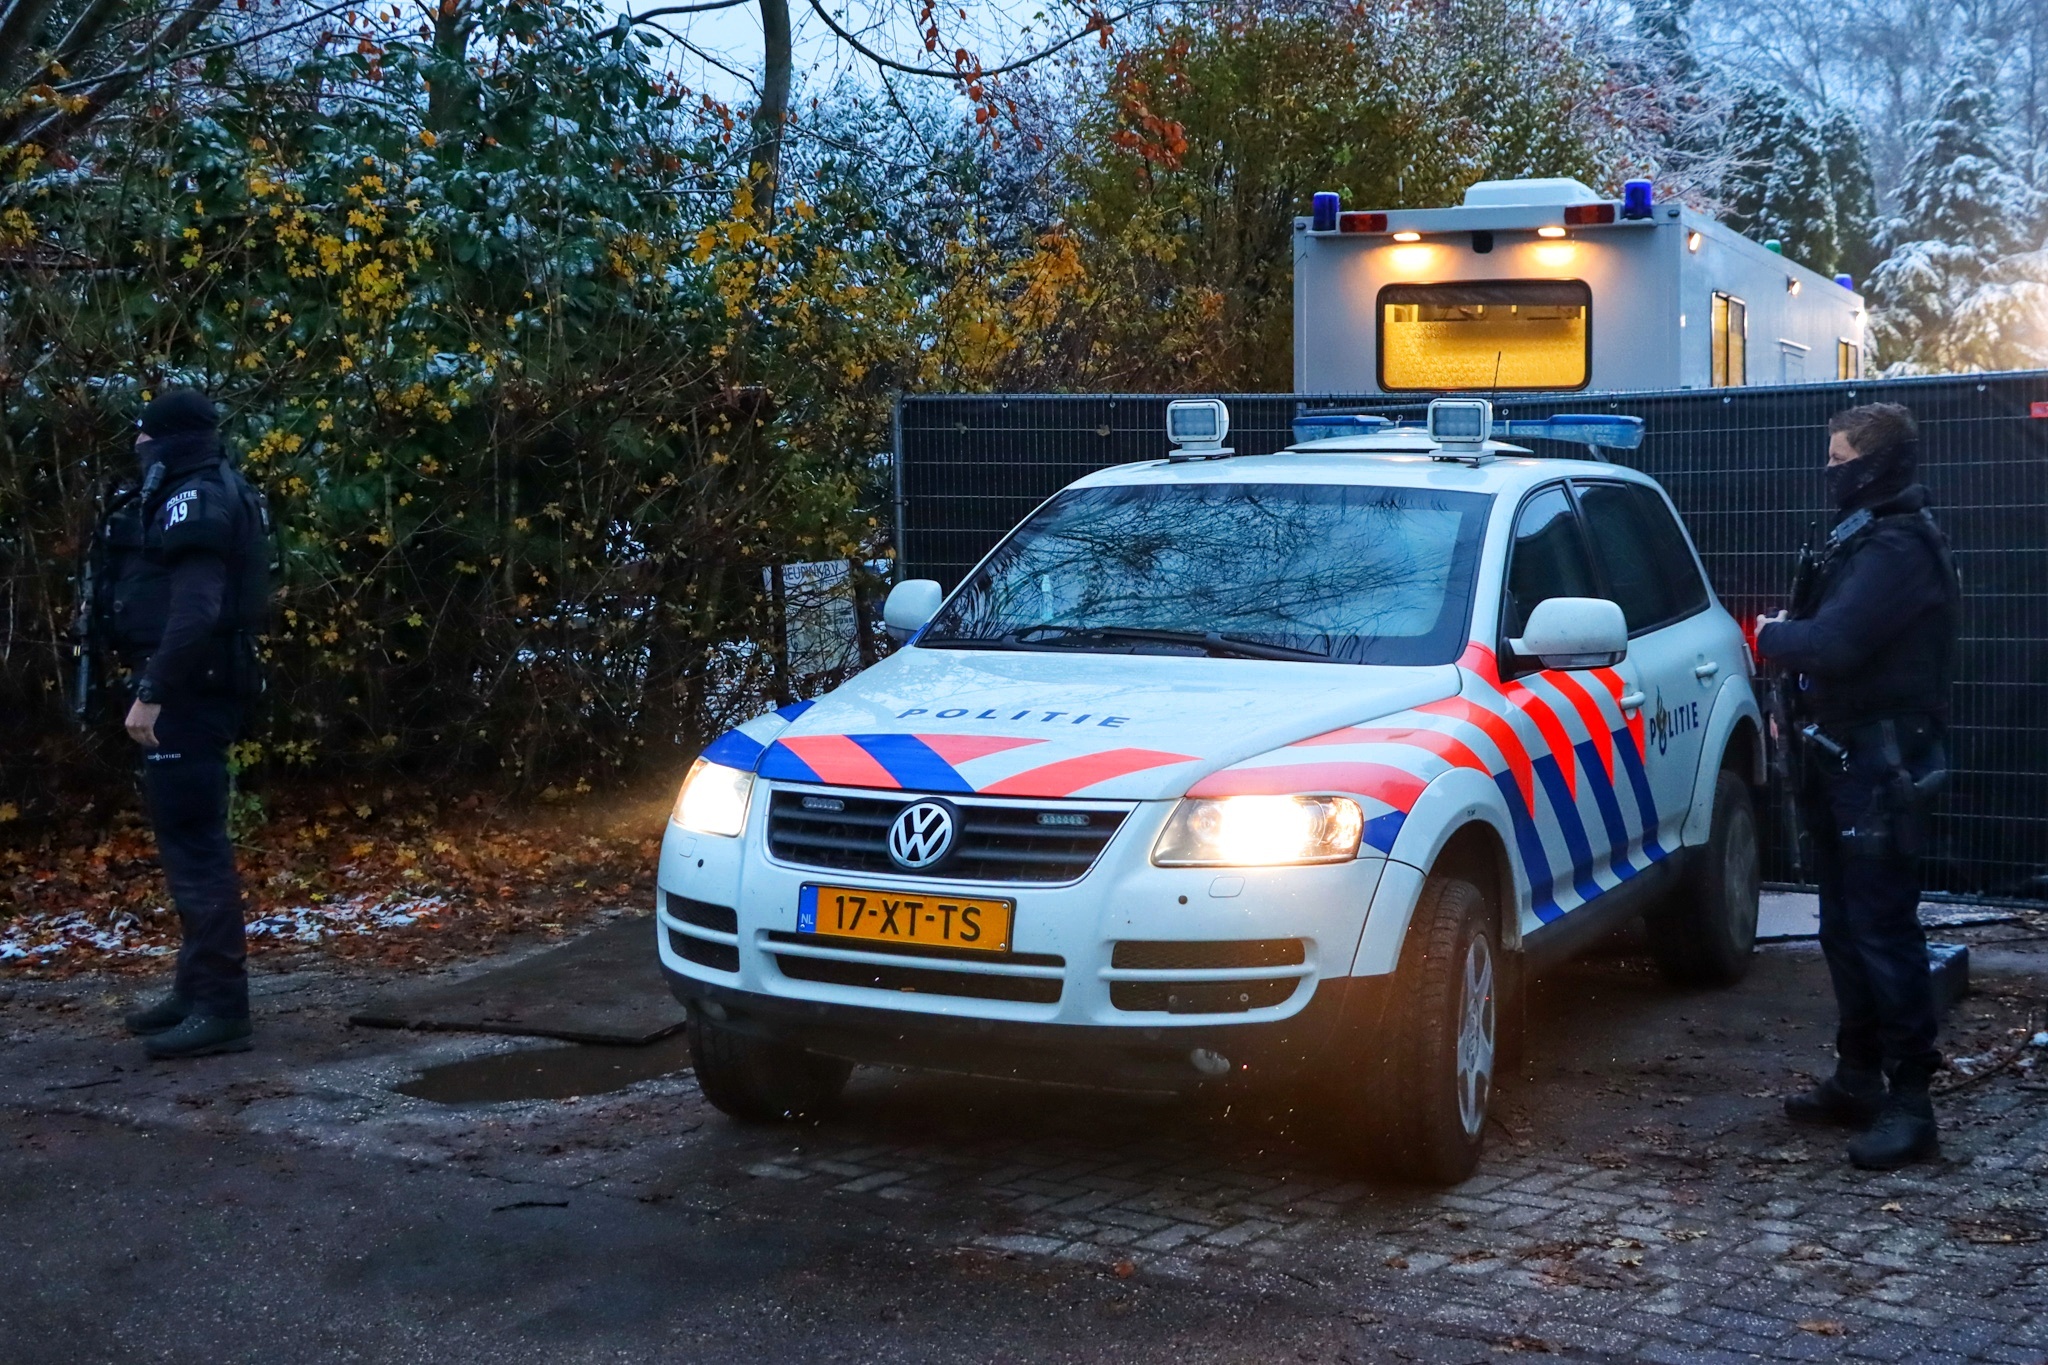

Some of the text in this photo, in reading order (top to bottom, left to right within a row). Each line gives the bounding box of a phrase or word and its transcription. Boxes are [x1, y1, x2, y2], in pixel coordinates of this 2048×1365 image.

[166, 489, 198, 509] POLITIE
[896, 708, 1131, 728] POLITIE
[1649, 701, 1699, 756] POLITIE
[801, 912, 814, 925] NL
[835, 895, 981, 942] 17-XT-TS
